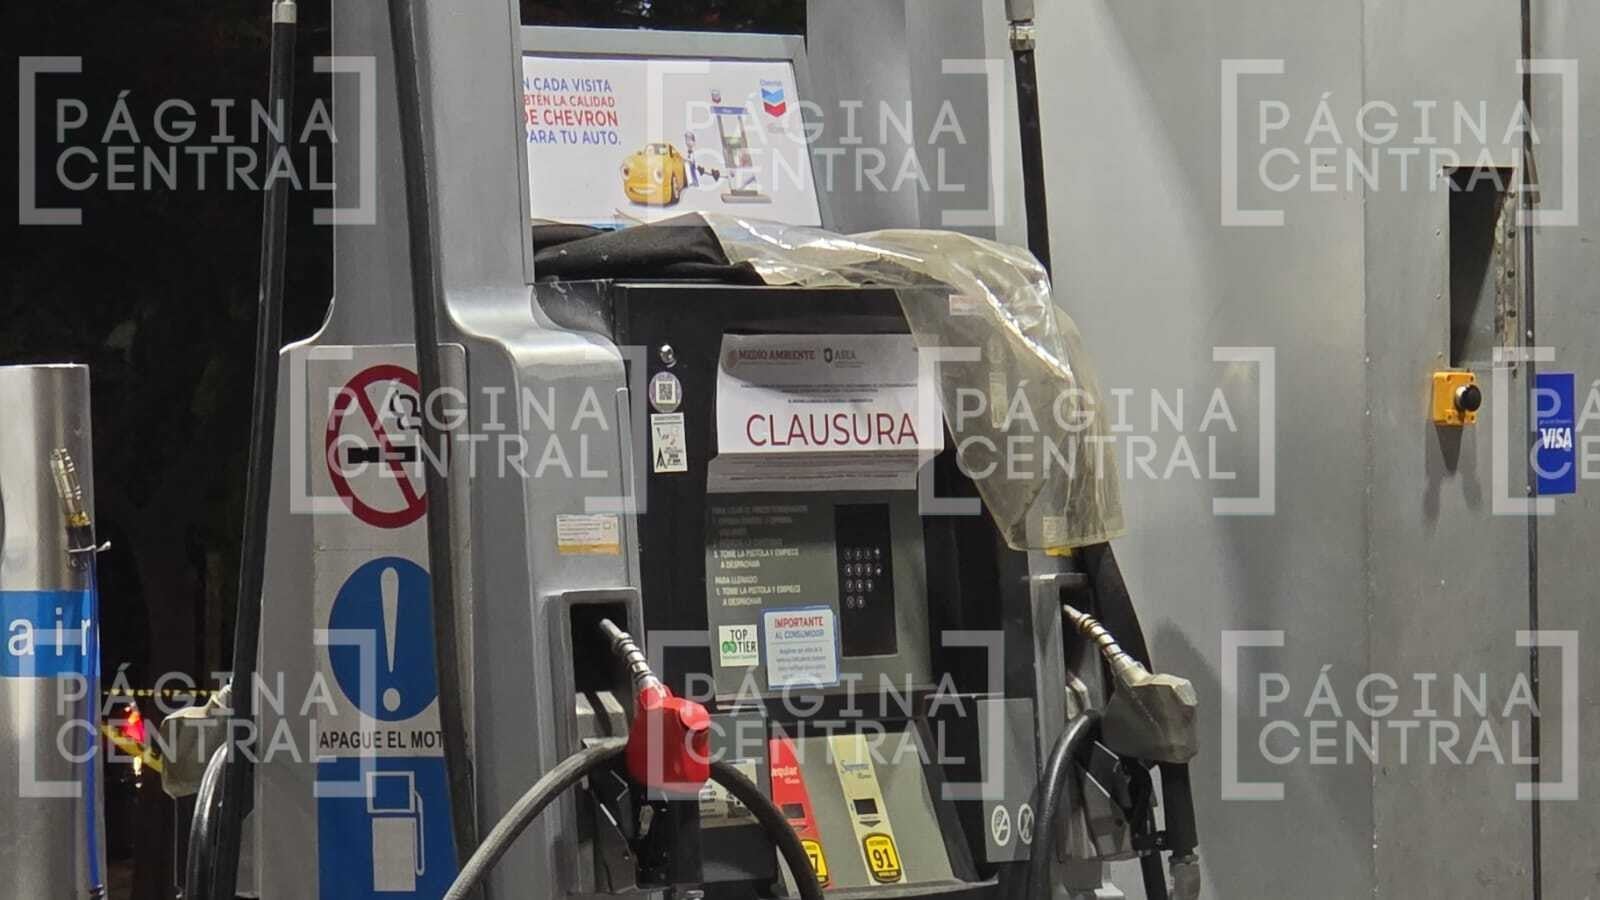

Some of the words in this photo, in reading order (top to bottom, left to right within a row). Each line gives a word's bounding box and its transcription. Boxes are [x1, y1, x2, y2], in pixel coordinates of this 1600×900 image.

[534, 77, 569, 92] CADA
[572, 79, 612, 93] VISITA
[523, 94, 550, 106] BTEN
[553, 95, 567, 106] LA
[569, 95, 615, 107] CALIDAD
[543, 109, 618, 127] CHEVRON
[526, 128, 557, 144] ARA
[560, 129, 577, 144] TU
[582, 130, 621, 145] AUTO.
[746, 413, 919, 446] CLAUSURA
[1540, 427, 1573, 448] VISA
[774, 616, 824, 628] IMPORTANTE
[8, 607, 91, 657] air
[730, 629, 748, 641] TOP
[737, 641, 757, 653] TIER
[319, 731, 381, 749] APAGUE
[387, 731, 406, 749] EL
[411, 731, 454, 749] MOT
[872, 848, 894, 869] 91
